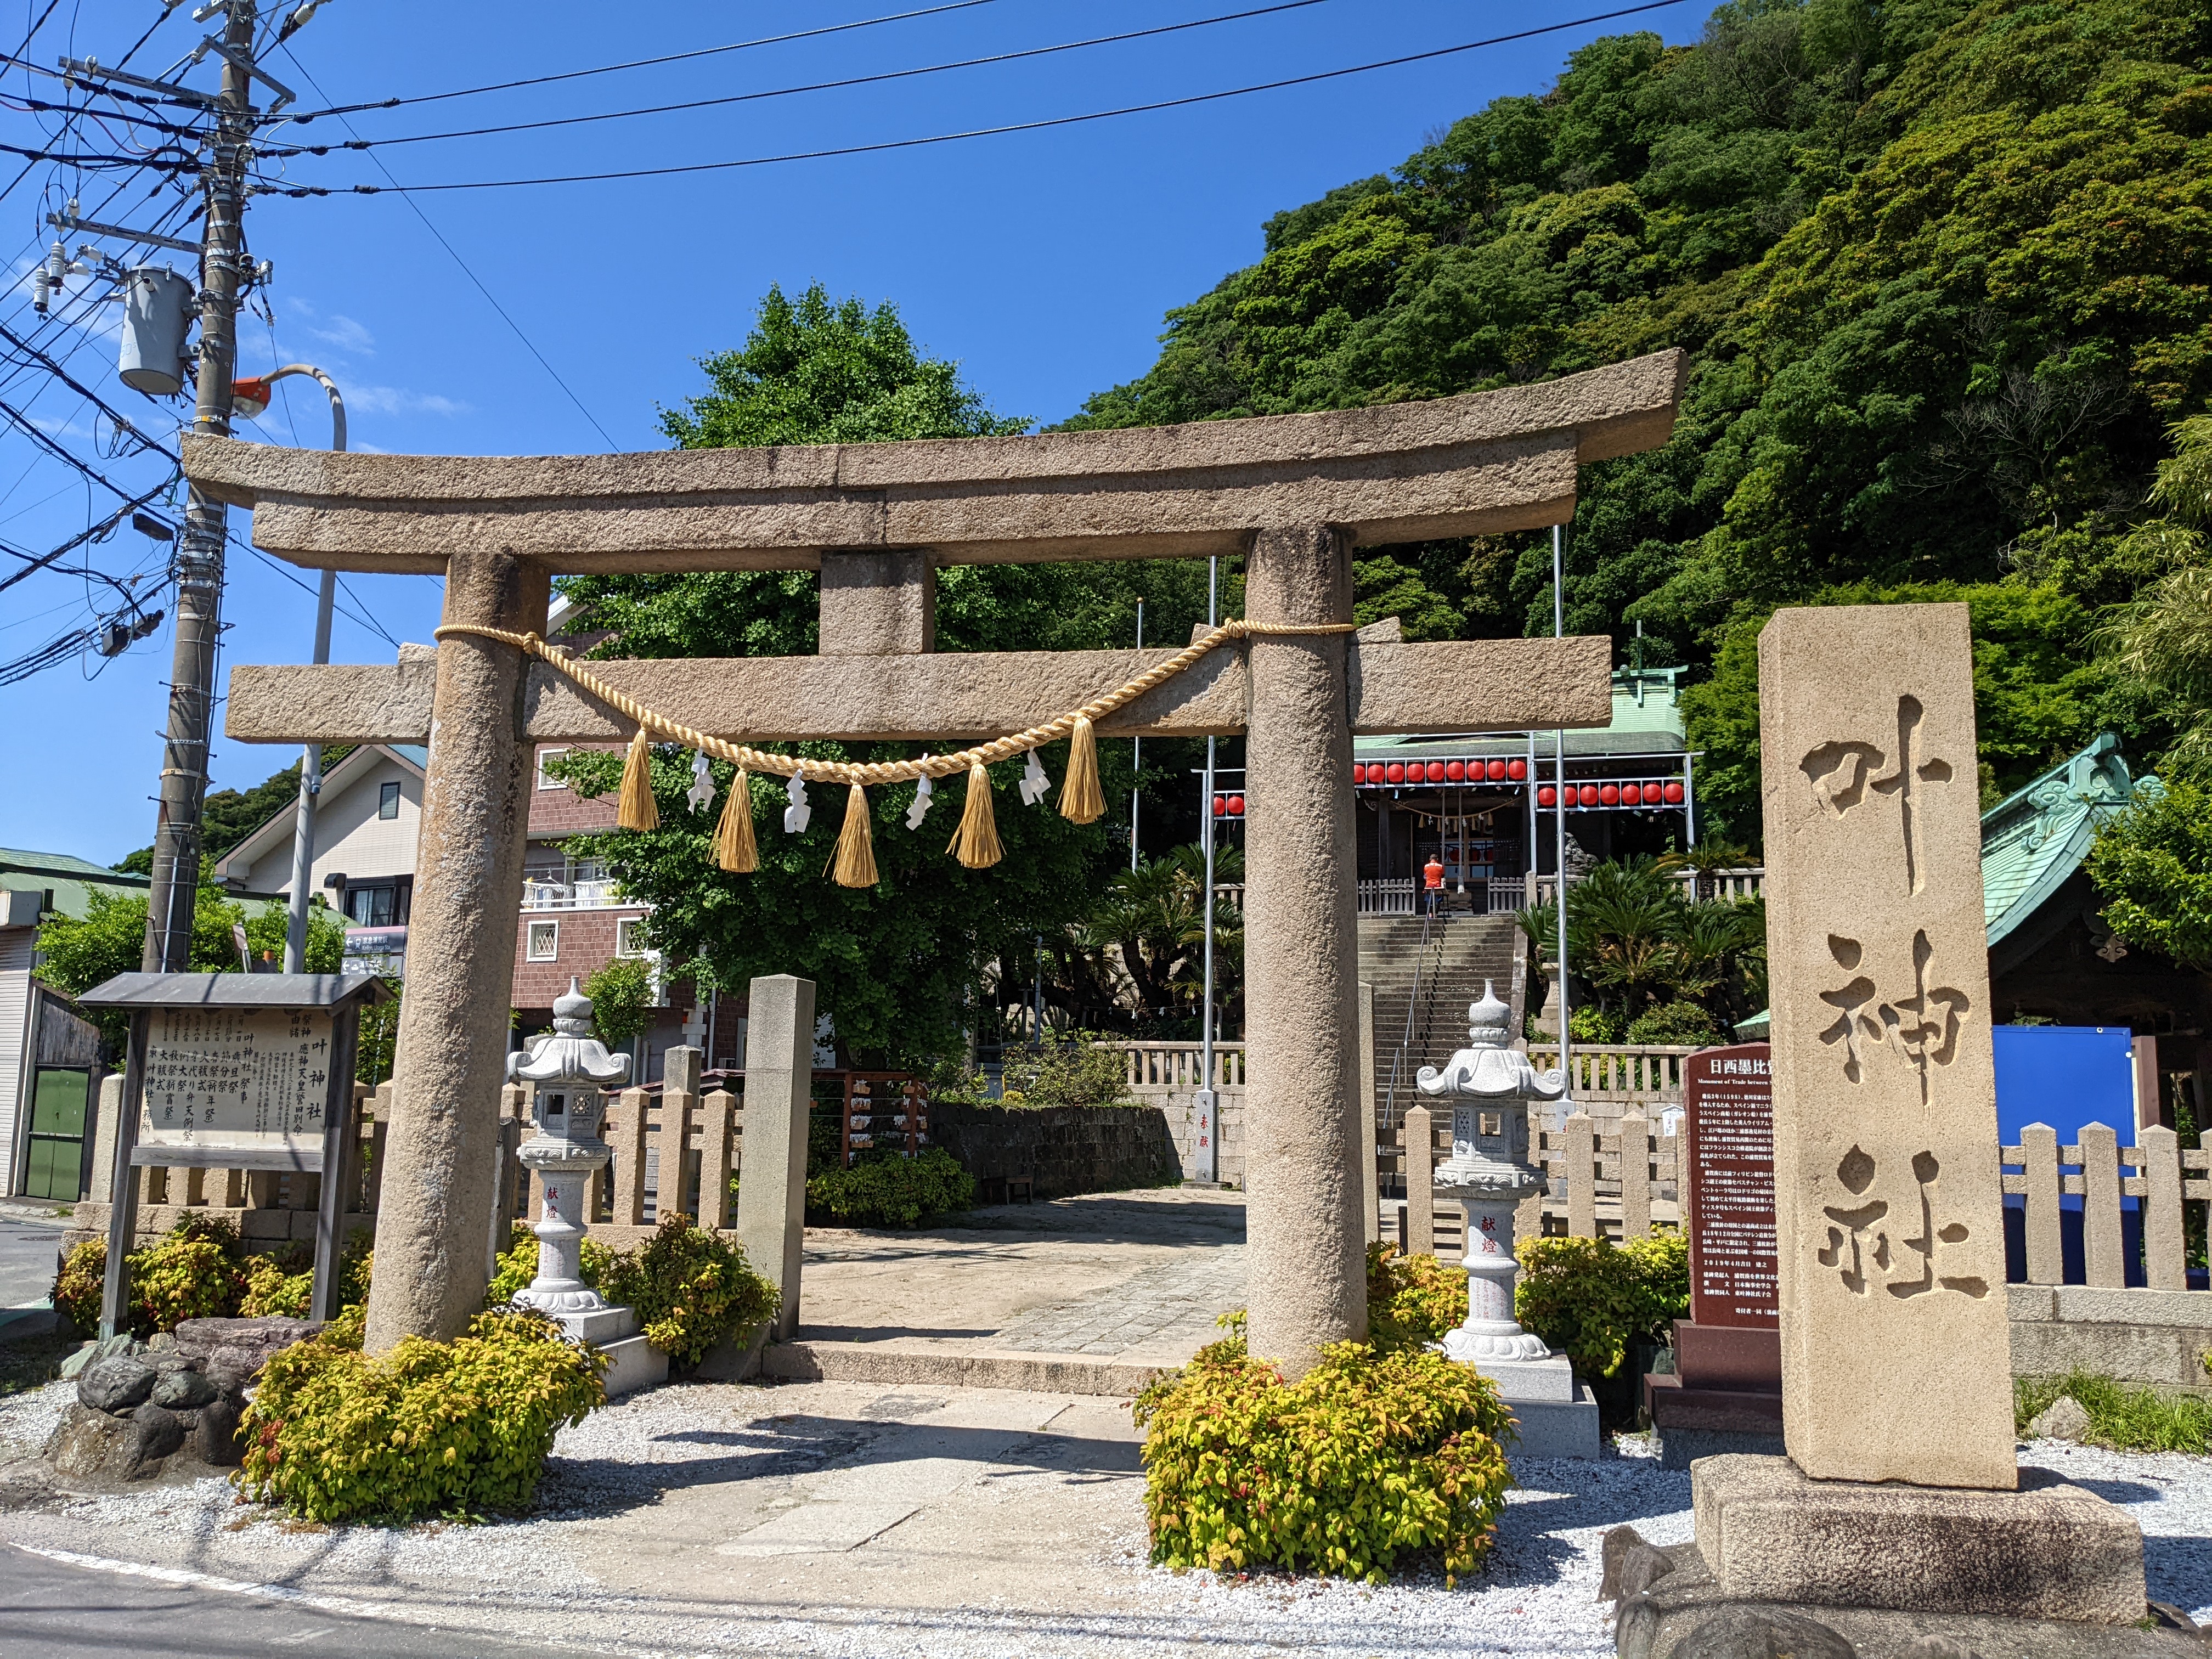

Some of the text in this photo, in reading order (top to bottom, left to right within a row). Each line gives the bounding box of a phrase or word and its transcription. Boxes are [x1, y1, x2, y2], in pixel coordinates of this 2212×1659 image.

[362, 936, 388, 944] 京急浦賀駅
[1798, 694, 1989, 1300] 叶神社
[290, 1014, 300, 1038] 由緒
[301, 1014, 312, 1038] 祭神
[306, 1038, 328, 1120] 叶神社
